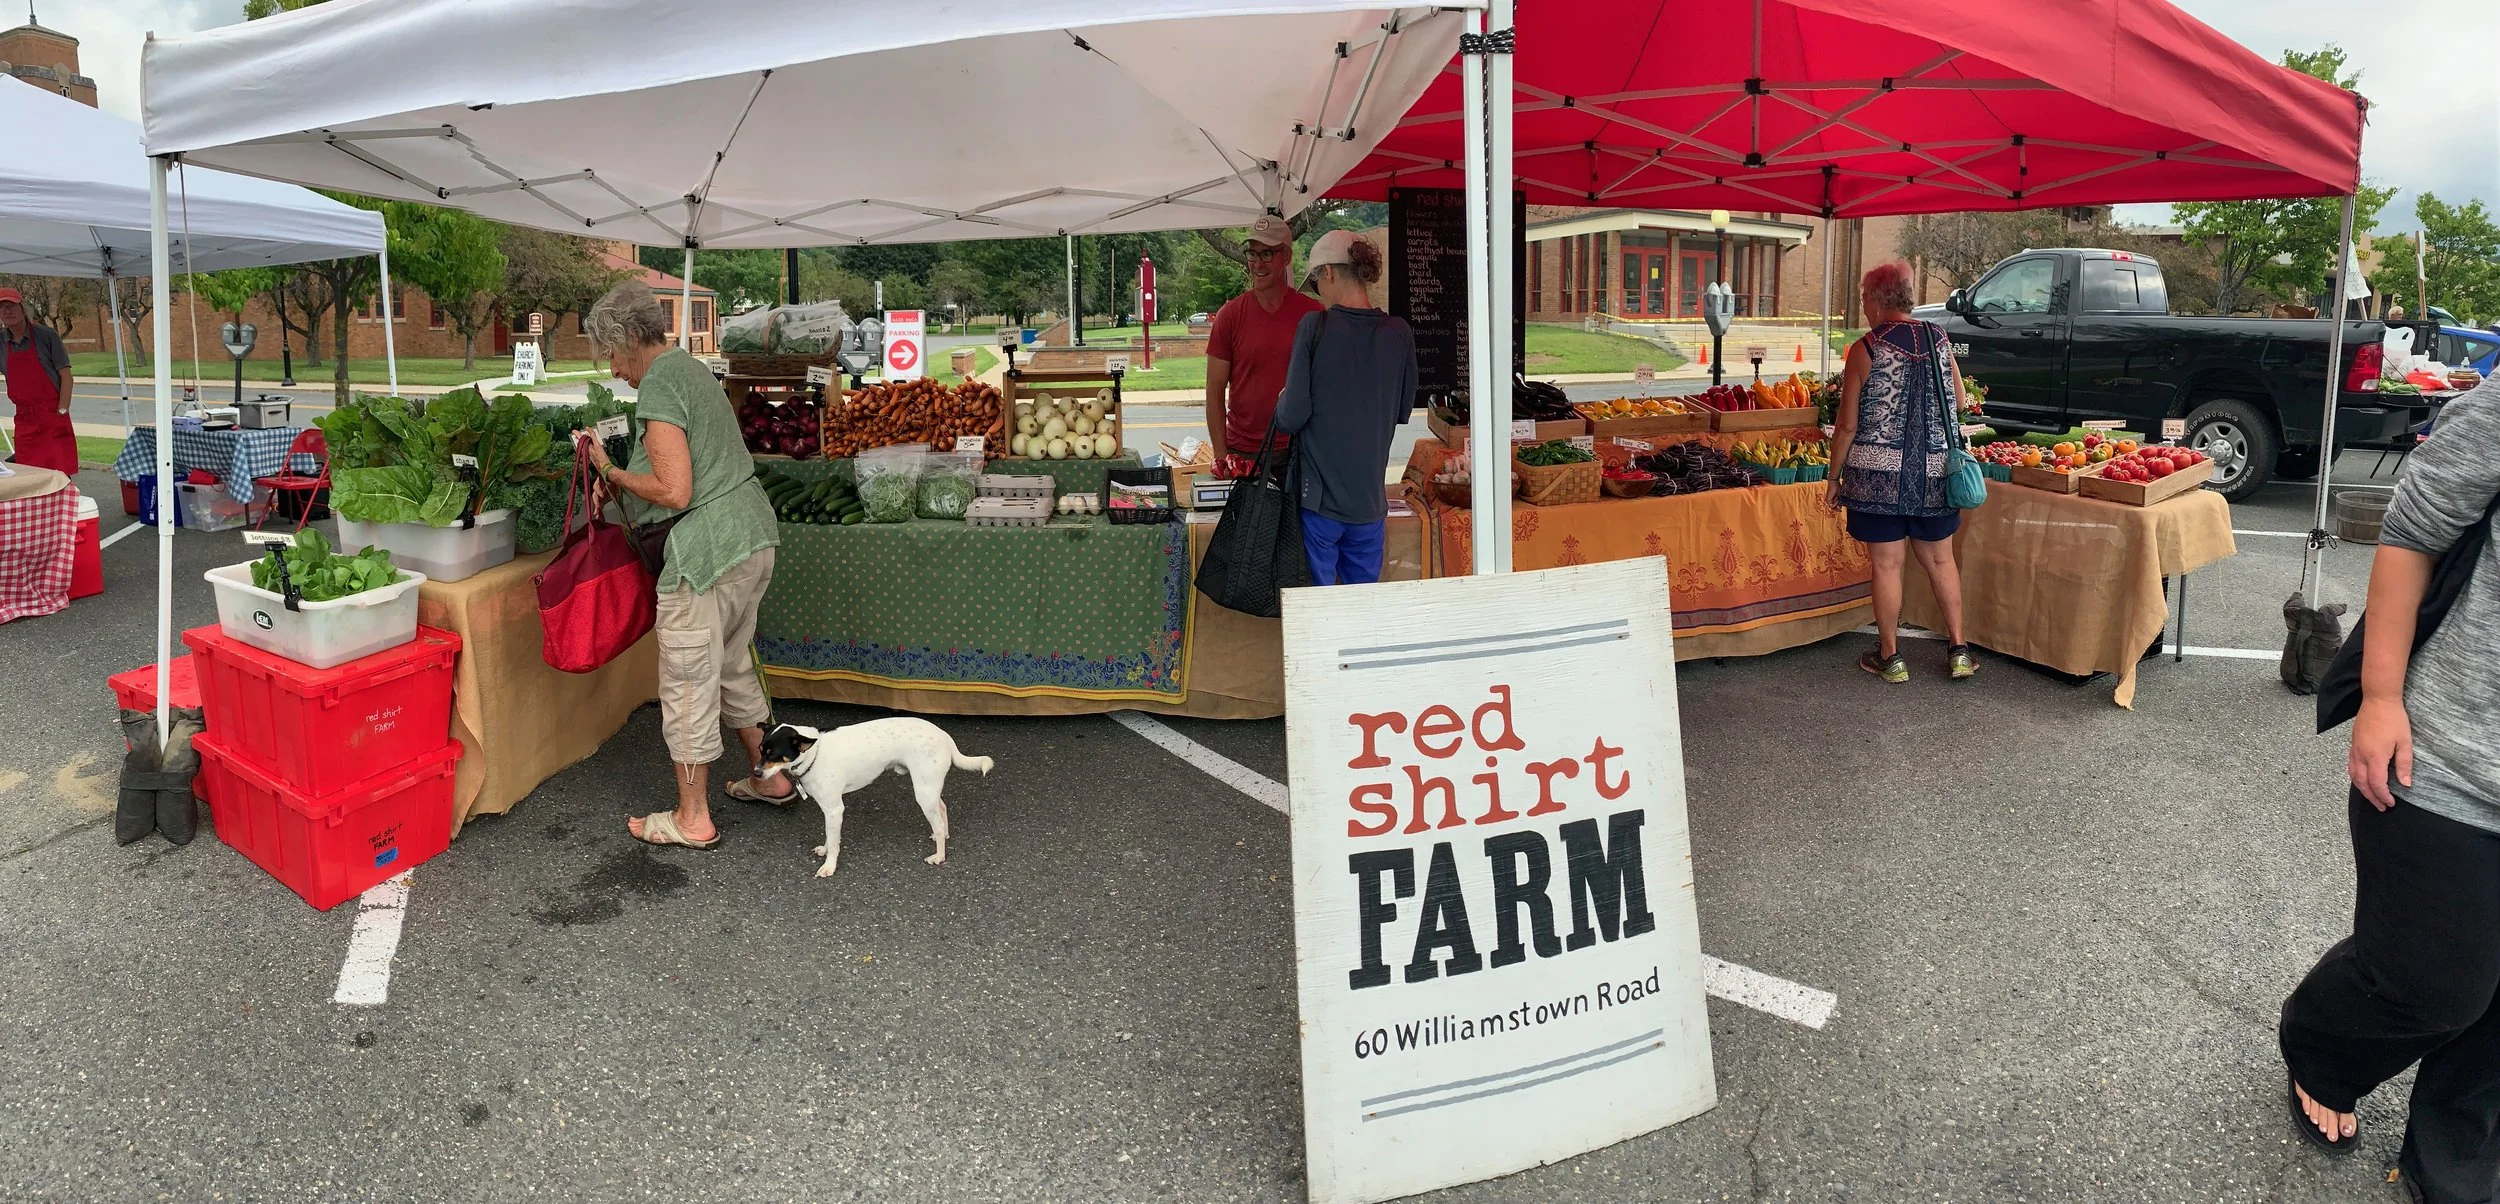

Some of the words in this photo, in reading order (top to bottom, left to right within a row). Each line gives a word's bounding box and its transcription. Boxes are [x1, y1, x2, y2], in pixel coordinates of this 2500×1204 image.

[1416, 191, 1440, 206] red
[1406, 228, 1433, 237] lettuce
[1407, 237, 1439, 246] carrots
[1406, 245, 1443, 256] amethyst
[1408, 261, 1430, 269] basil
[1408, 269, 1432, 277] chard
[1408, 277, 1441, 286] collards
[1409, 286, 1444, 296] eggplant
[1409, 295, 1434, 306] garlic
[1411, 305, 1428, 313] kale
[1411, 312, 1441, 323] squash
[517, 350, 534, 360] CHURCH
[1415, 347, 1440, 357] eppers
[515, 361, 535, 370] PARKING
[517, 372, 529, 381] ONLY
[365, 709, 379, 723] red
[382, 705, 404, 719] shirt
[374, 720, 395, 735] FARM
[1347, 684, 1526, 769] red
[1347, 735, 1632, 838] shirt
[368, 831, 381, 845] red
[383, 821, 404, 838] shirt
[373, 836, 395, 852] FARM
[1348, 808, 1656, 991] FARM
[1354, 1029, 1389, 1060] 60
[1395, 991, 1590, 1052] Williamstown
[1597, 965, 1662, 1012] Road
